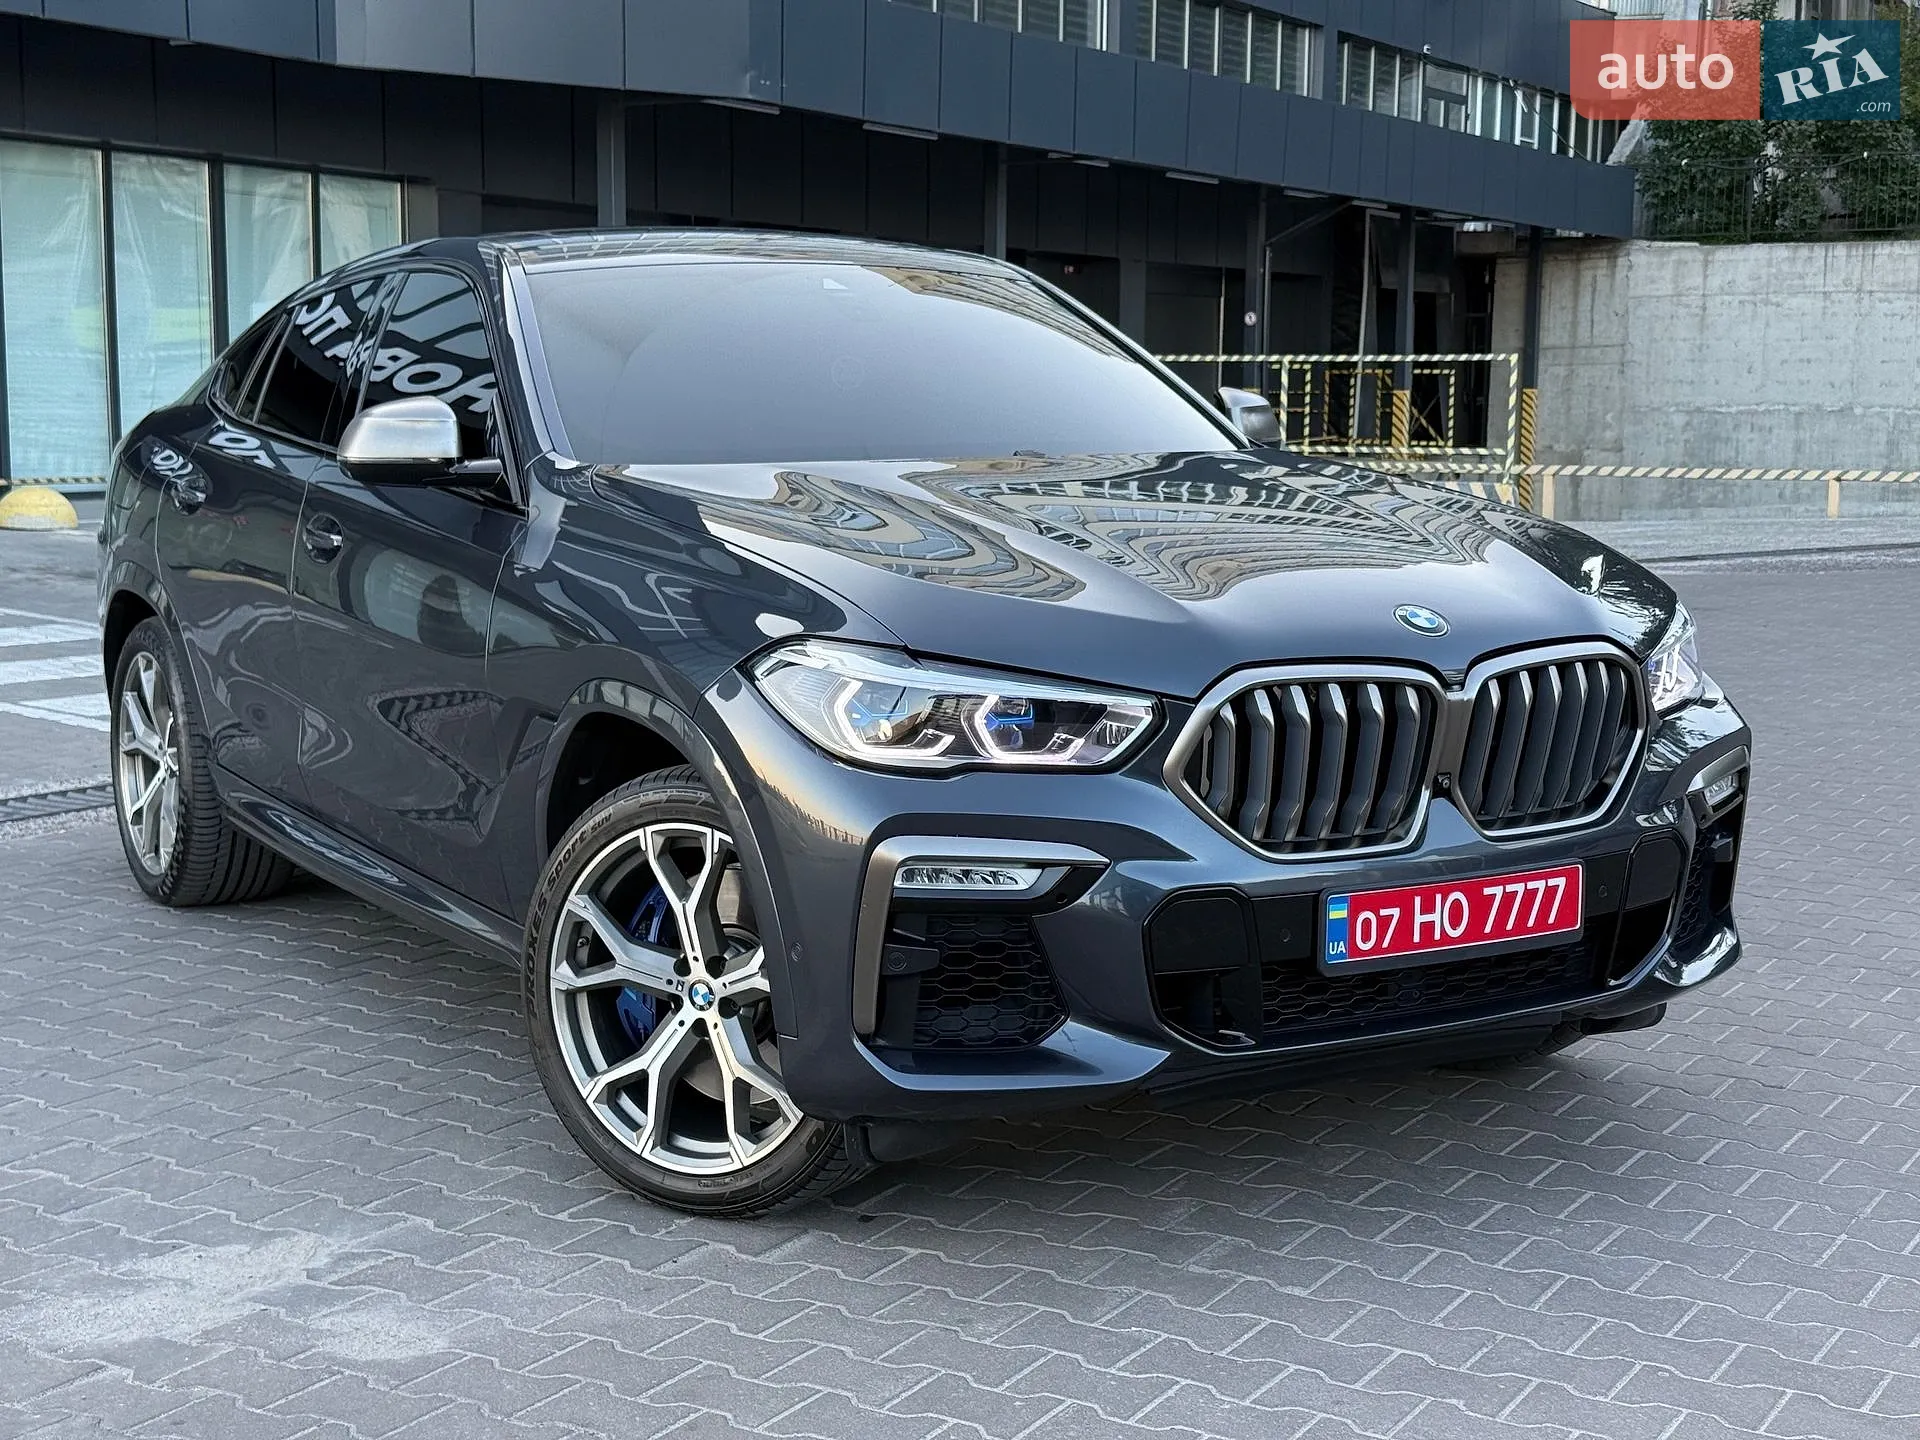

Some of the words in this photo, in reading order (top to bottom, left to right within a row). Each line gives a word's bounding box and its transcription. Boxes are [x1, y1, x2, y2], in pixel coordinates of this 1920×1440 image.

[1355, 907, 1401, 951] 07
[1412, 891, 1469, 943] HO
[1482, 876, 1567, 934] 7777
[1329, 941, 1346, 955] UA
